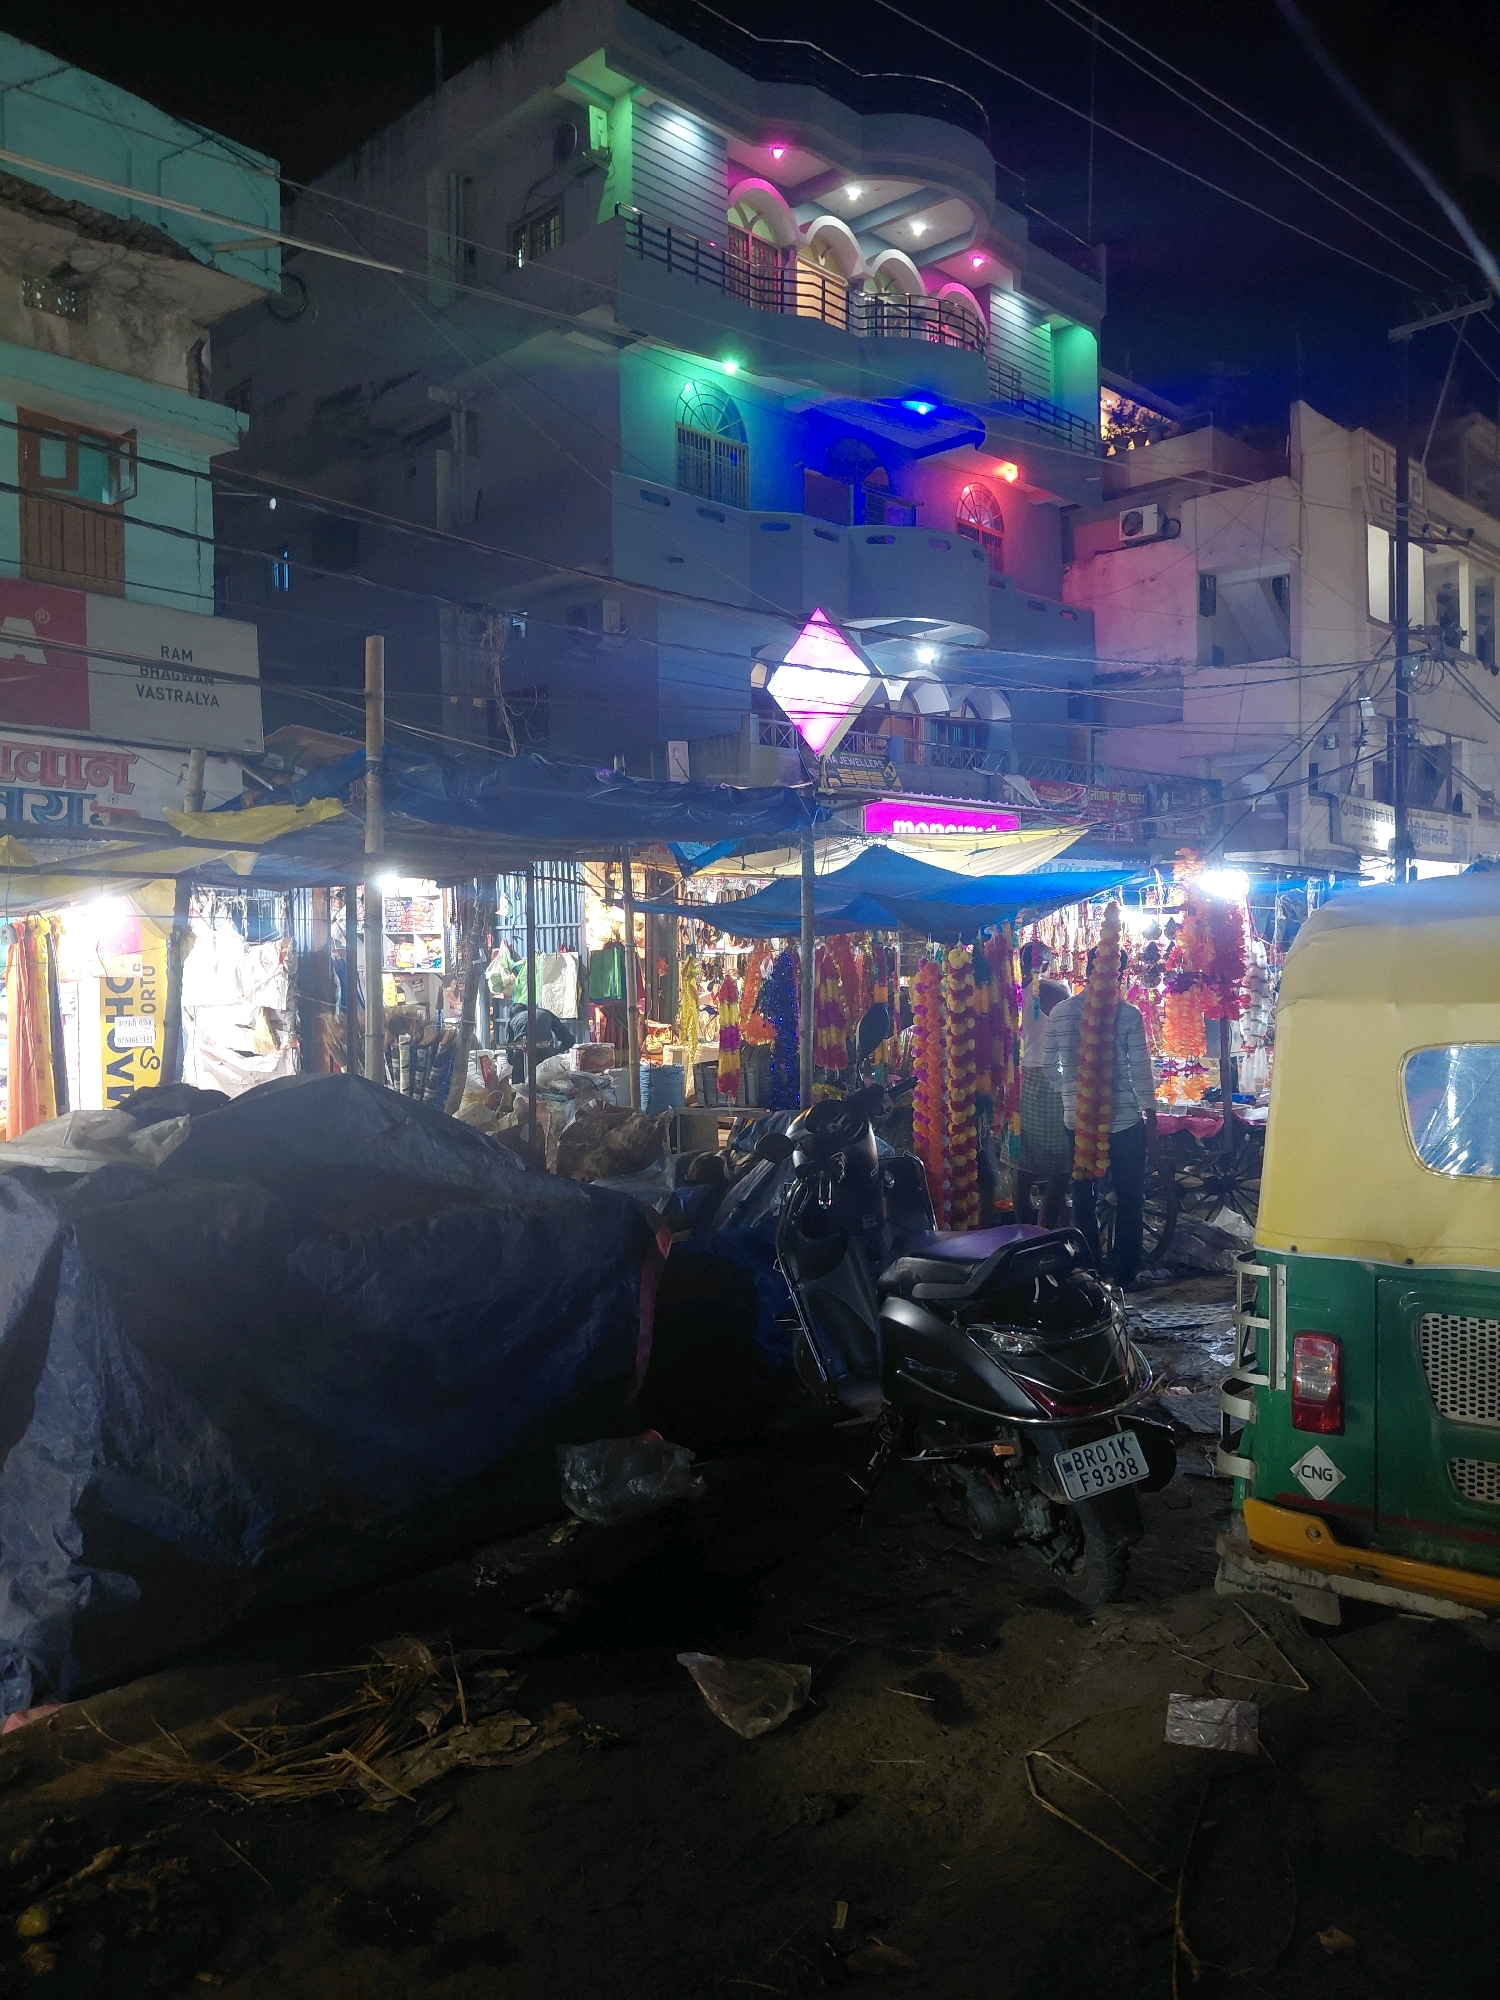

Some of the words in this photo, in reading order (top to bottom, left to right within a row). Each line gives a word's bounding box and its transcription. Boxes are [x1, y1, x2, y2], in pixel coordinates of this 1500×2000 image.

[160, 645, 193, 662] RAM
[135, 682, 219, 707] VASTRALYA
[839, 755, 885, 769] JEWELLERS
[1079, 1457, 1139, 1492] F9338
[1301, 1465, 1333, 1482] CNG
